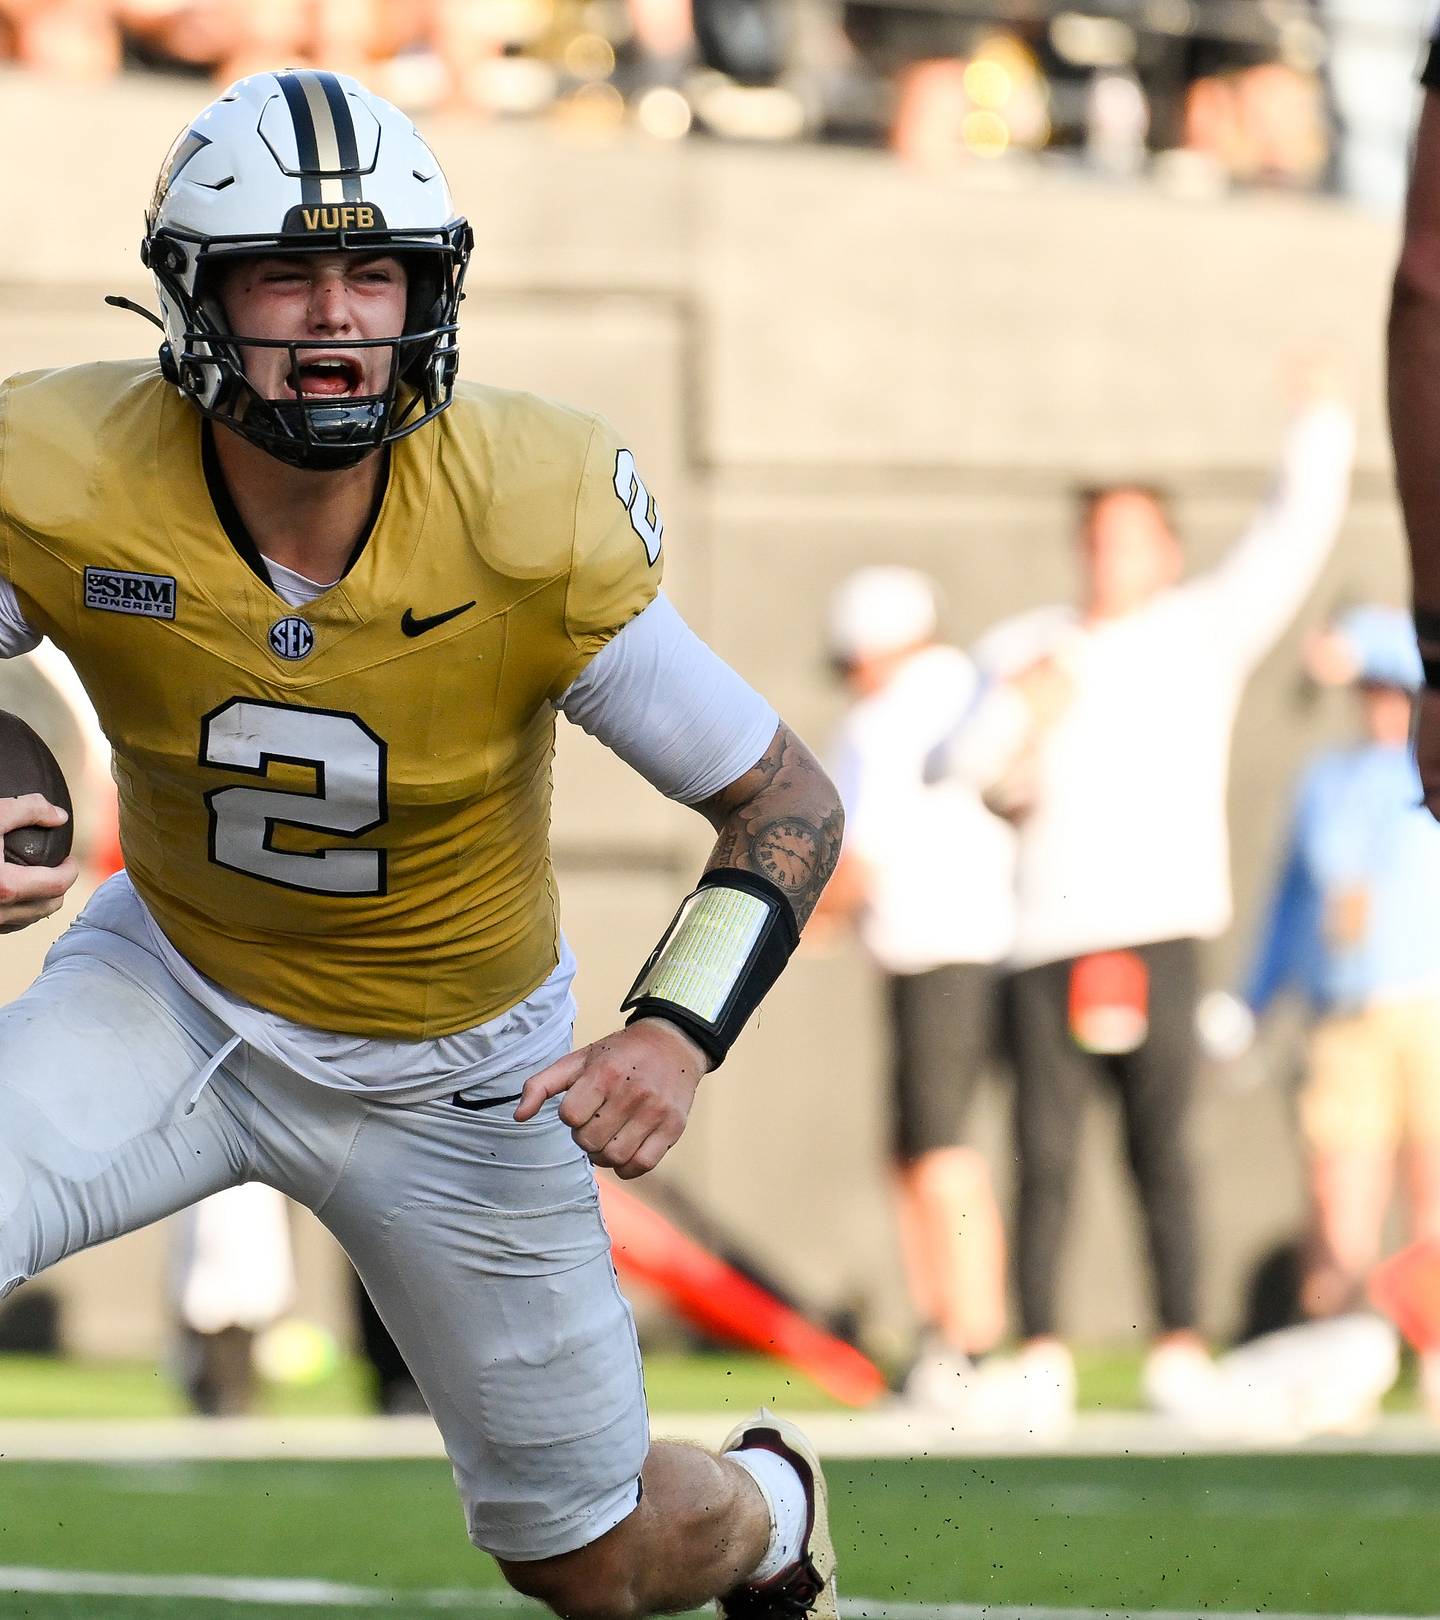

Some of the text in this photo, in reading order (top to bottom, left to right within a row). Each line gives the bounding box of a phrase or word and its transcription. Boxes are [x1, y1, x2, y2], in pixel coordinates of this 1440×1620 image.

[302, 207, 374, 230] VUFB
[613, 449, 664, 567] 2
[87, 594, 173, 615] CONCRETE
[102, 573, 173, 605] SRM
[272, 619, 312, 658] SEC
[198, 696, 388, 897] 2
